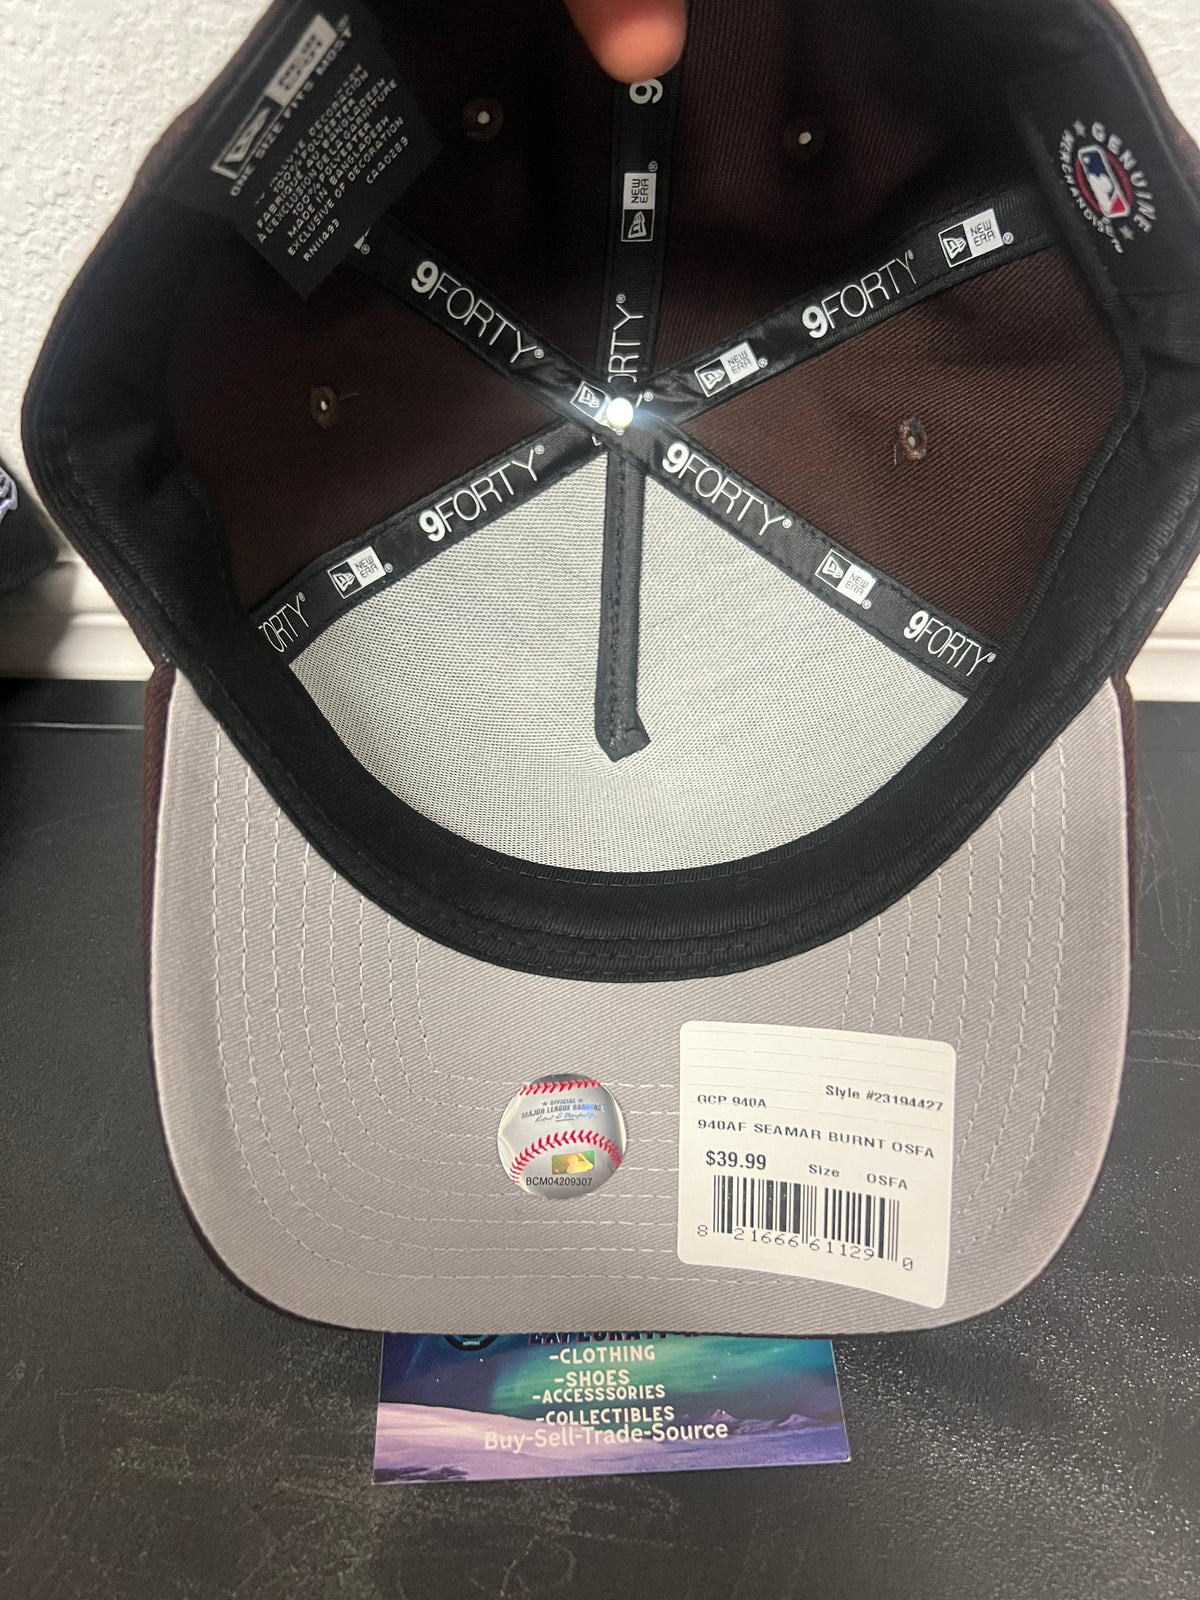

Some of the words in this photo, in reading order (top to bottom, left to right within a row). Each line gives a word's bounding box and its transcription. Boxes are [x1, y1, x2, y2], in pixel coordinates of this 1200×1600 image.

[254, 122, 283, 158] SIZE
[301, 98, 354, 158] POLYESTER
[306, 152, 320, 167] AU
[322, 78, 385, 148] BANGLADESH
[316, 155, 329, 169] DE
[329, 140, 342, 154] LA
[342, 80, 397, 138] GARNITURE
[288, 205, 314, 236] MADE
[316, 189, 328, 201] IN
[330, 115, 390, 184] BANGLADESH
[288, 199, 335, 254] EXCLUSIVE
[334, 183, 347, 198] OF
[348, 116, 404, 180] DECORATION
[292, 182, 320, 215] 100%
[319, 122, 371, 182] POLYESTER
[1091, 121, 1157, 233] GENUINE
[631, 178, 641, 204] NEW
[970, 220, 992, 237] NEW
[973, 231, 995, 247] ERA
[411, 261, 537, 363] 9FORTY
[802, 251, 917, 339] 9FORTY
[727, 350, 748, 367] NEW
[731, 357, 752, 375] ERA
[419, 448, 538, 542] 9FORTY
[662, 442, 785, 536] 9FORTY
[355, 555, 376, 572] NEW
[359, 564, 380, 579] ERA
[849, 573, 869, 589] NEW
[903, 610, 993, 677] 9FORTY
[547, 1104, 570, 1113] LEAGUE
[732, 1096, 767, 1109] 940A
[825, 1084, 860, 1100] Style
[866, 1090, 943, 1112] #23194427
[698, 1119, 747, 1132] 940AF
[753, 1123, 822, 1141] SEAMAR
[828, 1131, 886, 1150] BURNT
[892, 1141, 935, 1159] OSFA
[705, 1149, 767, 1171] $39.99
[808, 1163, 841, 1178] Size
[866, 1172, 909, 1191] OSFA
[526, 1176, 593, 1187] BCM04209307
[697, 1225, 708, 1238] 8
[733, 1228, 800, 1249] 21666
[809, 1239, 876, 1262] 61129
